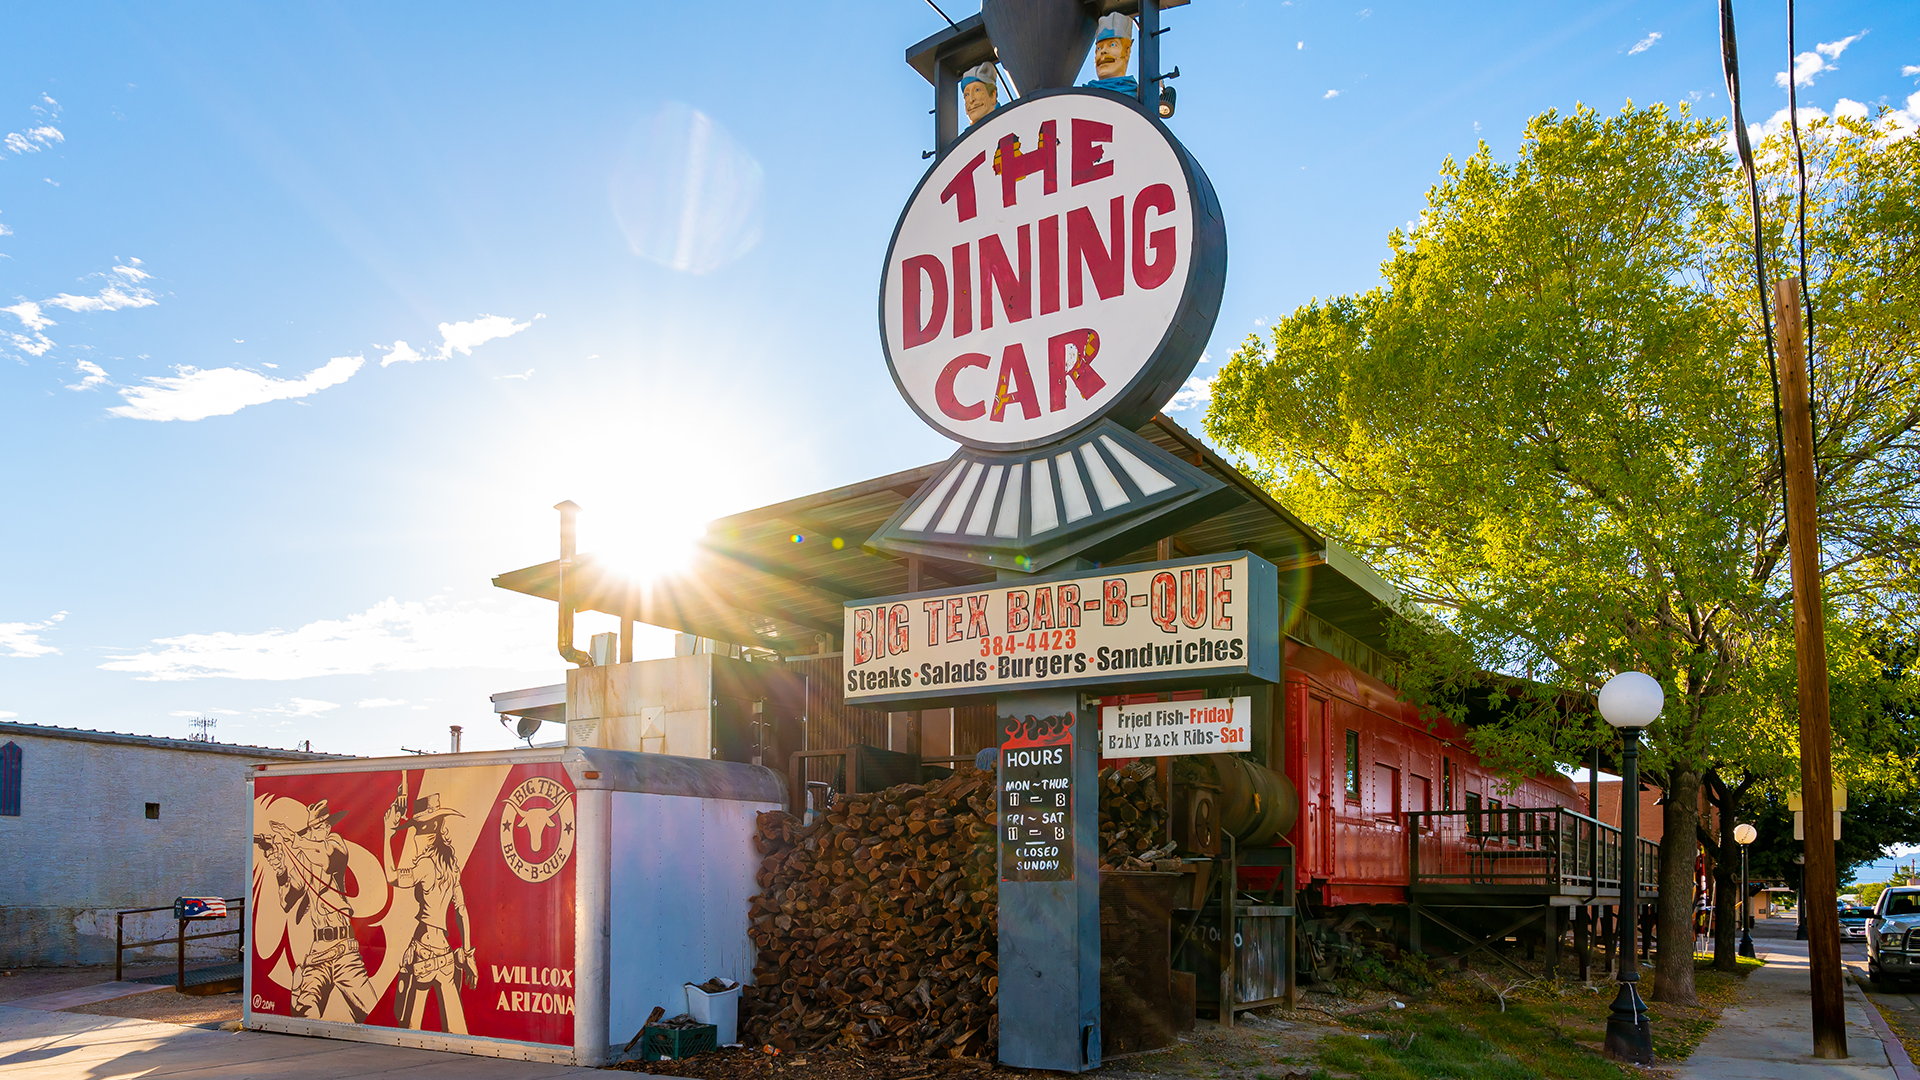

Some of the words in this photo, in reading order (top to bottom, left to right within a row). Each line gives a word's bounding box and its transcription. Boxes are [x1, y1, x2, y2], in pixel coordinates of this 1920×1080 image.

[940, 118, 1114, 223] THE
[902, 183, 1176, 350] DINING
[934, 328, 1107, 422] CAR
[854, 603, 910, 666] BIG
[923, 594, 990, 647] TEX
[1007, 565, 1232, 634] BAR-B-QUE
[980, 629, 1076, 658] 384-4423
[848, 666, 912, 692] Steaks
[920, 659, 987, 686] Salads
[998, 653, 1086, 680] Burgers
[1096, 638, 1243, 671] Sandwiches
[1118, 711, 1152, 729] Fried
[1108, 734, 1140, 750] Baby
[1145, 731, 1179, 748] Back
[1007, 748, 1063, 767] HOURS
[513, 780, 536, 805] BIG
[538, 779, 565, 803] TEX
[1005, 780, 1030, 791] MON
[1041, 778, 1069, 790] THUR
[1010, 793, 1019, 806] 11
[1056, 793, 1065, 806] 8
[1007, 814, 1023, 826] FRI
[1042, 812, 1065, 824] SAT
[1008, 827, 1018, 840] 11
[1055, 827, 1064, 840] 8
[504, 843, 567, 879] BAR-B-QUE
[1016, 846, 1058, 857] CLOSED
[1016, 860, 1059, 871] SUNDAY
[491, 965, 573, 988] WILLCOX
[496, 991, 575, 1016] ARIZONA
